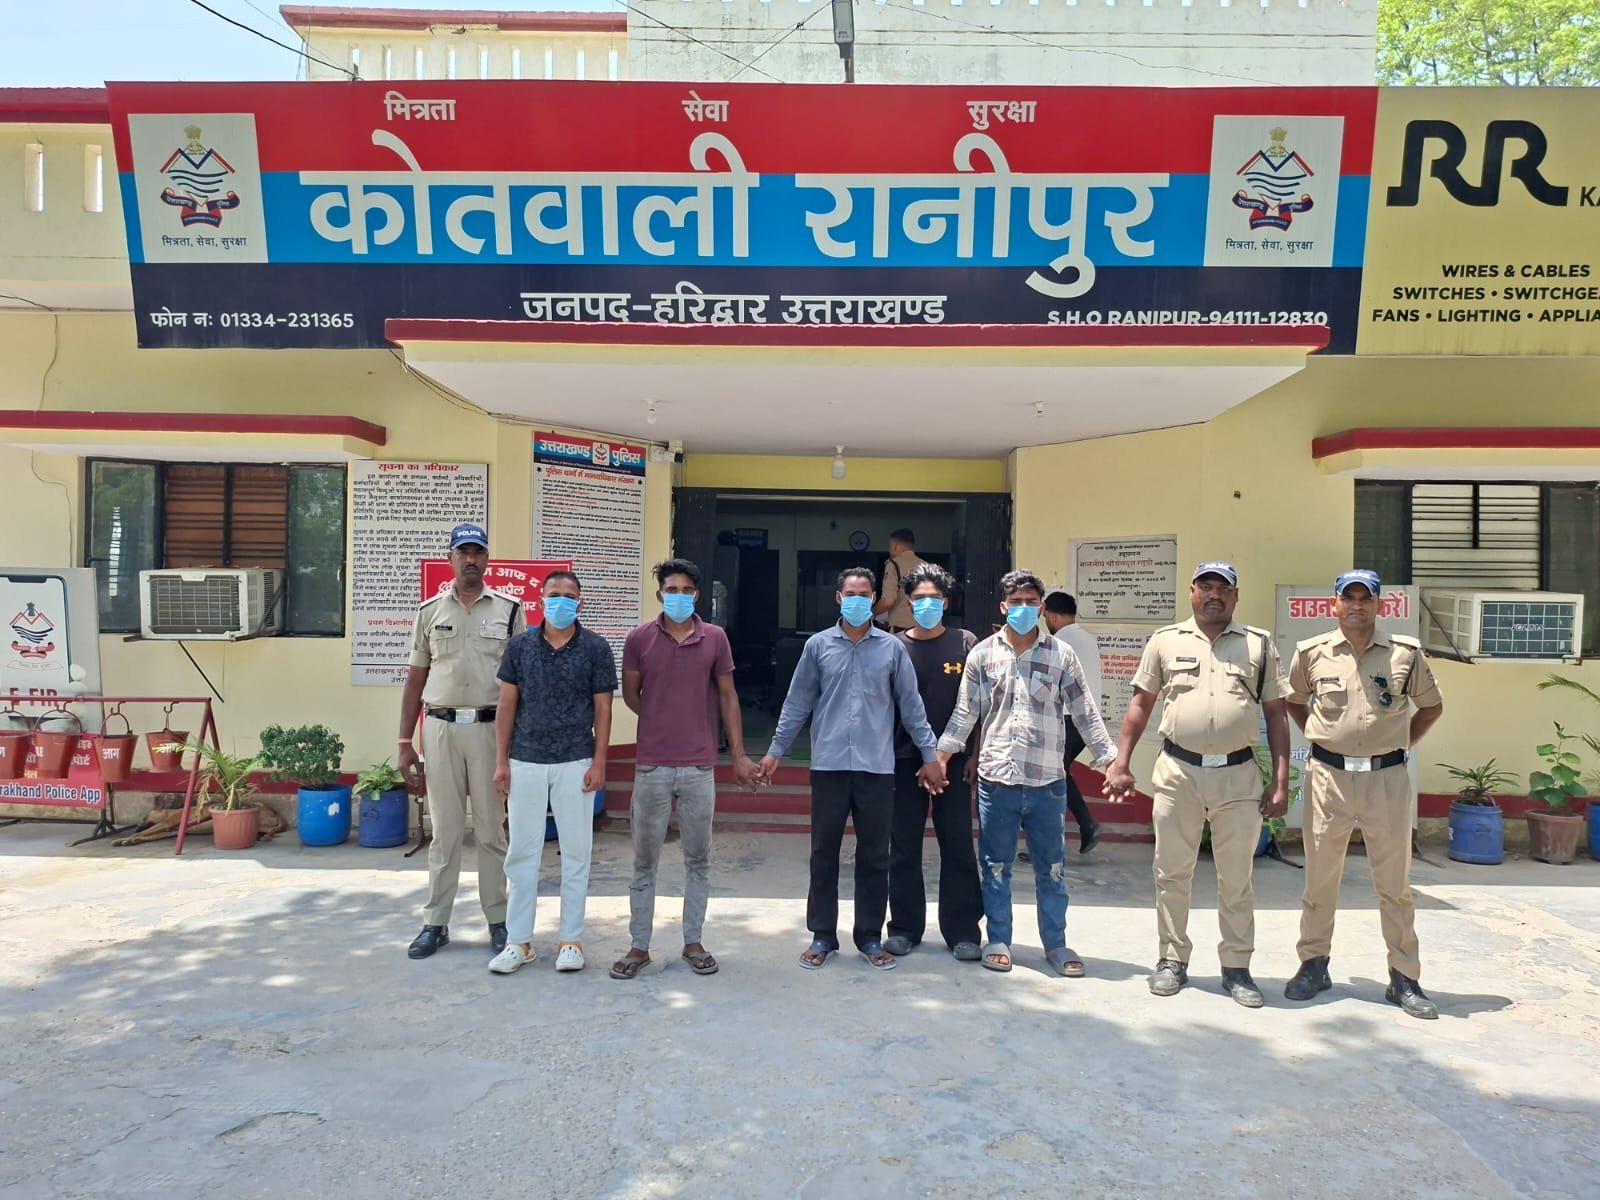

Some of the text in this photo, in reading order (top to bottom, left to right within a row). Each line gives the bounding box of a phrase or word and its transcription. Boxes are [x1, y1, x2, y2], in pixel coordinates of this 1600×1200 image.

[384, 91, 455, 120] मित्रता
[682, 91, 729, 121] सेवा
[967, 100, 1036, 130] सुरक्षा
[1387, 120, 1600, 206] RR K
[299, 130, 1170, 298] कोतवाली रानीपुर
[162, 235, 247, 249] मित्रता, सेवा, सुरक्षा
[1226, 238, 1314, 253] मित्रता, सेवा, सुरक्षा
[1442, 265, 1591, 277] WIRES & CABLES
[520, 281, 948, 324] जनपद-हरिद्वार उत्तराखण्ड
[1393, 287, 1600, 300] SWITCHES SWITCHGE
[150, 307, 188, 327] फोन
[221, 312, 354, 328] 01334-231365
[1048, 311, 1328, 325] S.H.O RANIPUR-94111-12830
[1372, 310, 1420, 322] FANS
[1438, 310, 1521, 322] LIGHTING
[540, 440, 641, 466] उत्तराखण्ड पुलिस
[378, 463, 459, 472] सूचना का अधिकार
[1288, 597, 1337, 618] डाउन
[45, 784, 77, 799] Police
[80, 786, 100, 804] App
